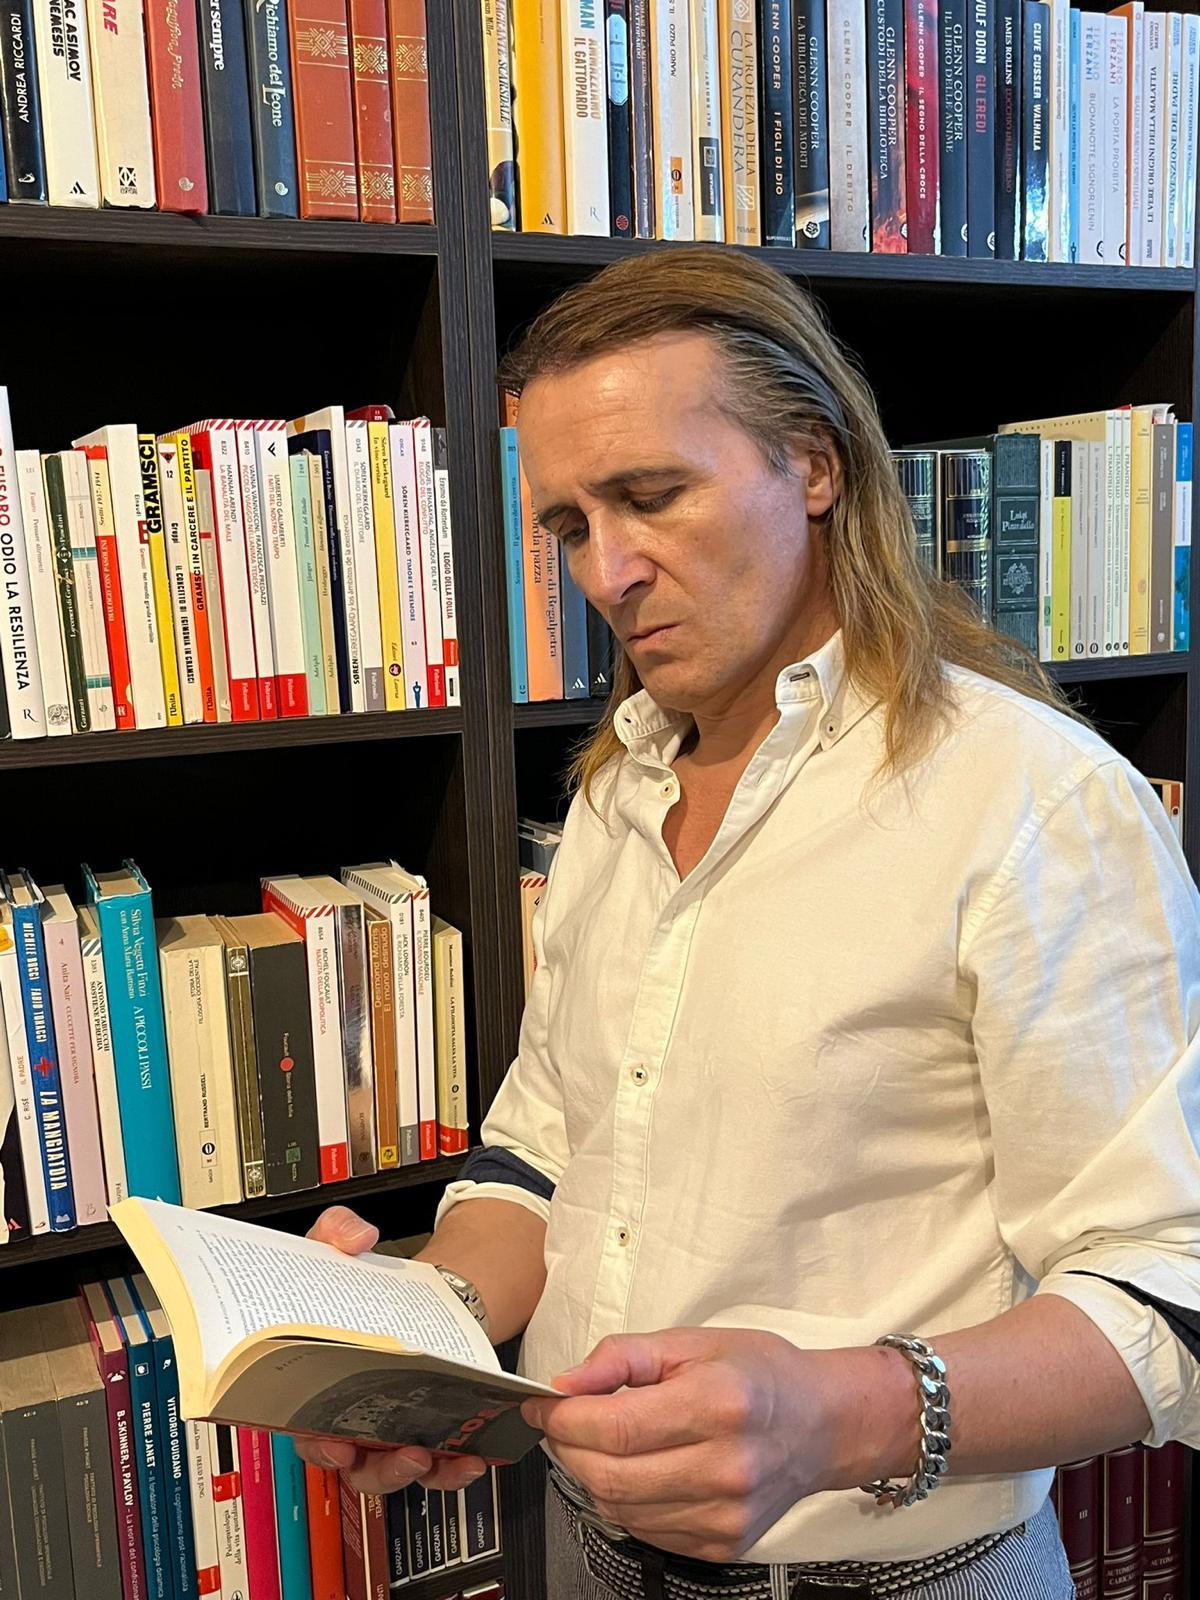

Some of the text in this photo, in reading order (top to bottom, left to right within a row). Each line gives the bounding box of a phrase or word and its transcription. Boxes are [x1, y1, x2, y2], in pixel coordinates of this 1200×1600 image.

[50, 0, 63, 56] NEMESIS
[210, 11, 225, 70] sempre
[843, 20, 851, 65] GLENN
[1004, 16, 1012, 84] JAMES ROLLINS
[10, 13, 29, 123] ANDREA RICCARDI
[574, 38, 588, 118] IL GATTOPARDO
[772, 36, 781, 89] COOPER
[878, 60, 886, 101] DELLA
[886, 27, 896, 145] GLENN COOPER
[945, 11, 954, 153] IL LIBRO DELLE ANIME
[953, 24, 963, 140] GLENN COOPER
[976, 30, 987, 133] DORN GLI EREDI
[1033, 23, 1041, 151] CLIVE CUSSLER WALHALLA
[262, 64, 286, 127] del Leone
[498, 60, 511, 124] SCARSDALE
[731, 30, 745, 173] CURANDERA
[744, 32, 756, 176] LA PROFEZIA DELLA
[797, 16, 807, 168] LA BIBLIOTECA DEI MORTI
[810, 37, 819, 149] GLENN COOPER
[844, 73, 852, 127] COOPER
[919, 87, 925, 95] IL
[1112, 97, 1120, 110] LA
[774, 120, 782, 151] FIGLI
[845, 145, 852, 156] IL
[879, 105, 887, 179] BIBLIOTECA
[774, 156, 782, 170] DI
[775, 174, 783, 195] DIO
[140, 434, 162, 534] GRAMSCI
[182, 439, 193, 482] PARTITO
[249, 464, 257, 488] VANNA
[439, 477, 448, 498] Erasmo
[134, 494, 142, 516] Einaudi
[186, 485, 194, 493] IL
[226, 464, 237, 523] HANNAH ARENDT
[274, 474, 286, 547] UMBERTO GALIMBERTI
[362, 485, 370, 530] KIERKEGAARD
[1010, 510, 1027, 521] Luigi
[187, 505, 199, 551] CARCERE
[243, 464, 258, 594] PICCOLO VIAGGIO NELL'ANIMA TEDESCA
[403, 509, 412, 555] KIERKEGAARD
[440, 508, 449, 538] Rotterdam
[1002, 520, 1034, 531] Pirandello
[192, 554, 200, 564] IN
[255, 534, 264, 572] FRANCESCA
[405, 558, 413, 583] TIMORE
[531, 550, 543, 583] pazza
[102, 540, 114, 622] DIALOGO CON PASOLINI
[193, 566, 204, 611] GRAMSCI
[258, 574, 267, 605] PREDAZZI
[407, 591, 415, 621] TREMORE
[443, 552, 454, 618] ELOGIO DELLA FOLLIA
[0, 533, 30, 690] ODIO LA RESILIENZA
[545, 579, 558, 657] di Regalpetra
[131, 908, 148, 997] Silvia Vegetti Finzi
[371, 928, 382, 1008] Desmond Morris
[380, 927, 391, 1012] El mono desnudo
[61, 962, 71, 1002] Anita Nair
[90, 981, 103, 1050] SOSTIENE PEREIRA
[97, 981, 110, 1051] ANTONIO TABUCCHI
[318, 996, 326, 1034] BIOPOLITICA
[133, 1006, 151, 1089] A PICCOLI PASSI
[40, 1091, 67, 1190] LA MANGIATOIA
[117, 1410, 127, 1419] B.
[118, 1421, 130, 1462] SKINNER,
[141, 1402, 155, 1467] PIERRE JANET
[167, 1396, 182, 1478] VITTORIO GUIDANO
[122, 1473, 134, 1505] PAVLOV
[224, 1510, 232, 1557] Psicopatologia
[233, 1534, 242, 1565] della vita
